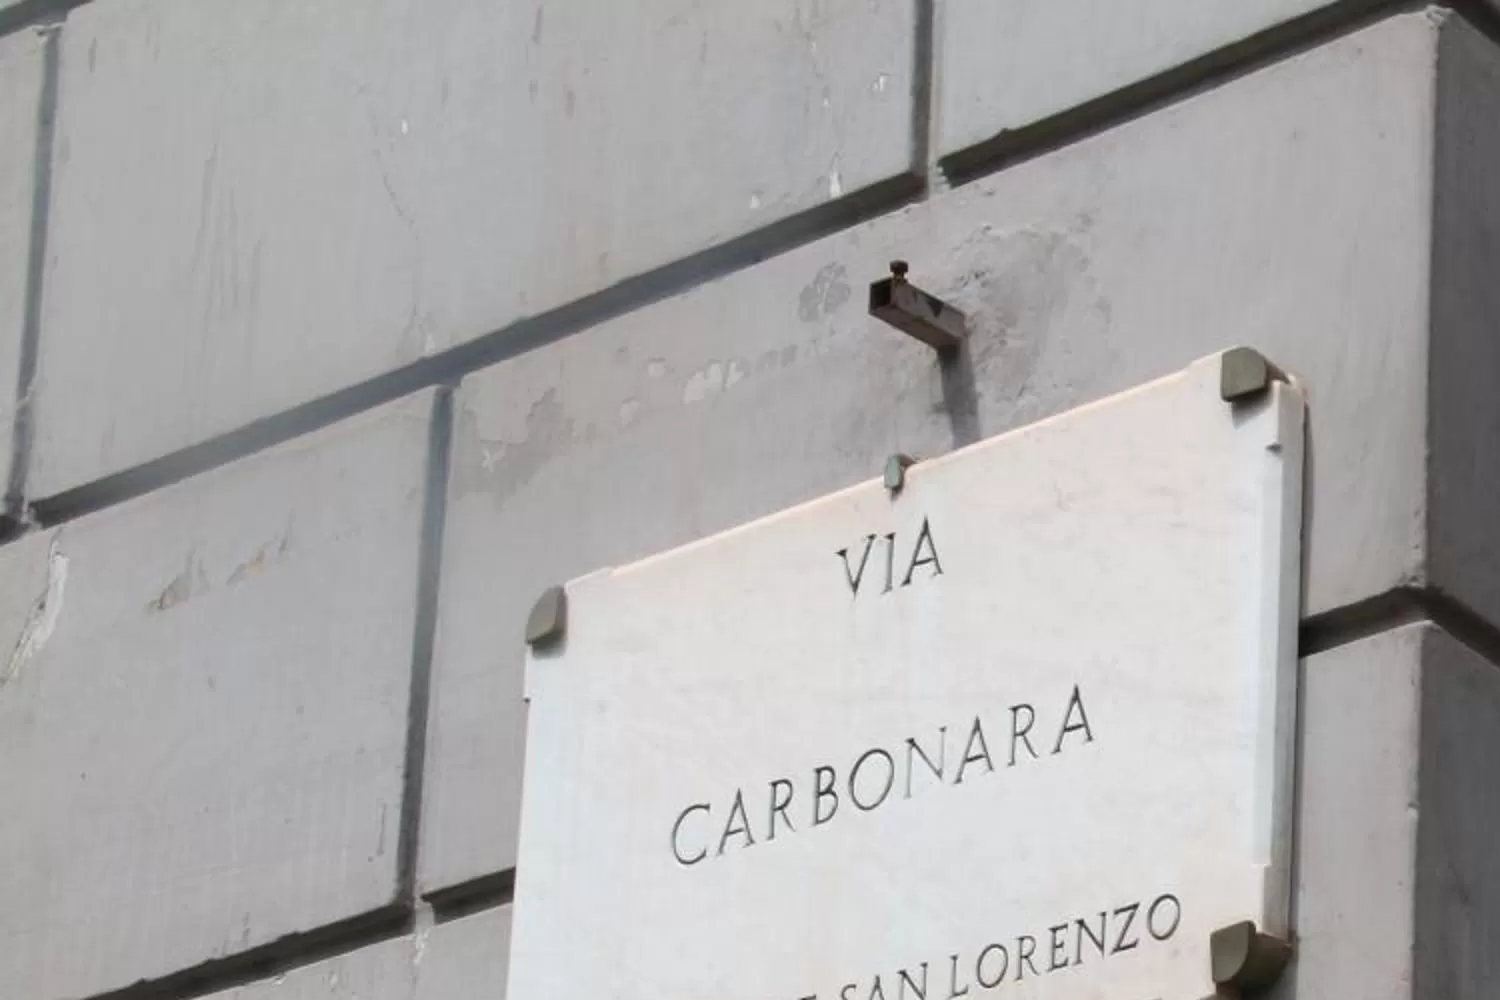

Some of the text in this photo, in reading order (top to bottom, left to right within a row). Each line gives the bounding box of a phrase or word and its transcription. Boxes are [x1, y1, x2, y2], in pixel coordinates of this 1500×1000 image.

[836, 514, 944, 598] VIA
[670, 683, 1095, 867] CARBONARA
[948, 892, 1184, 1000] LORENZO
